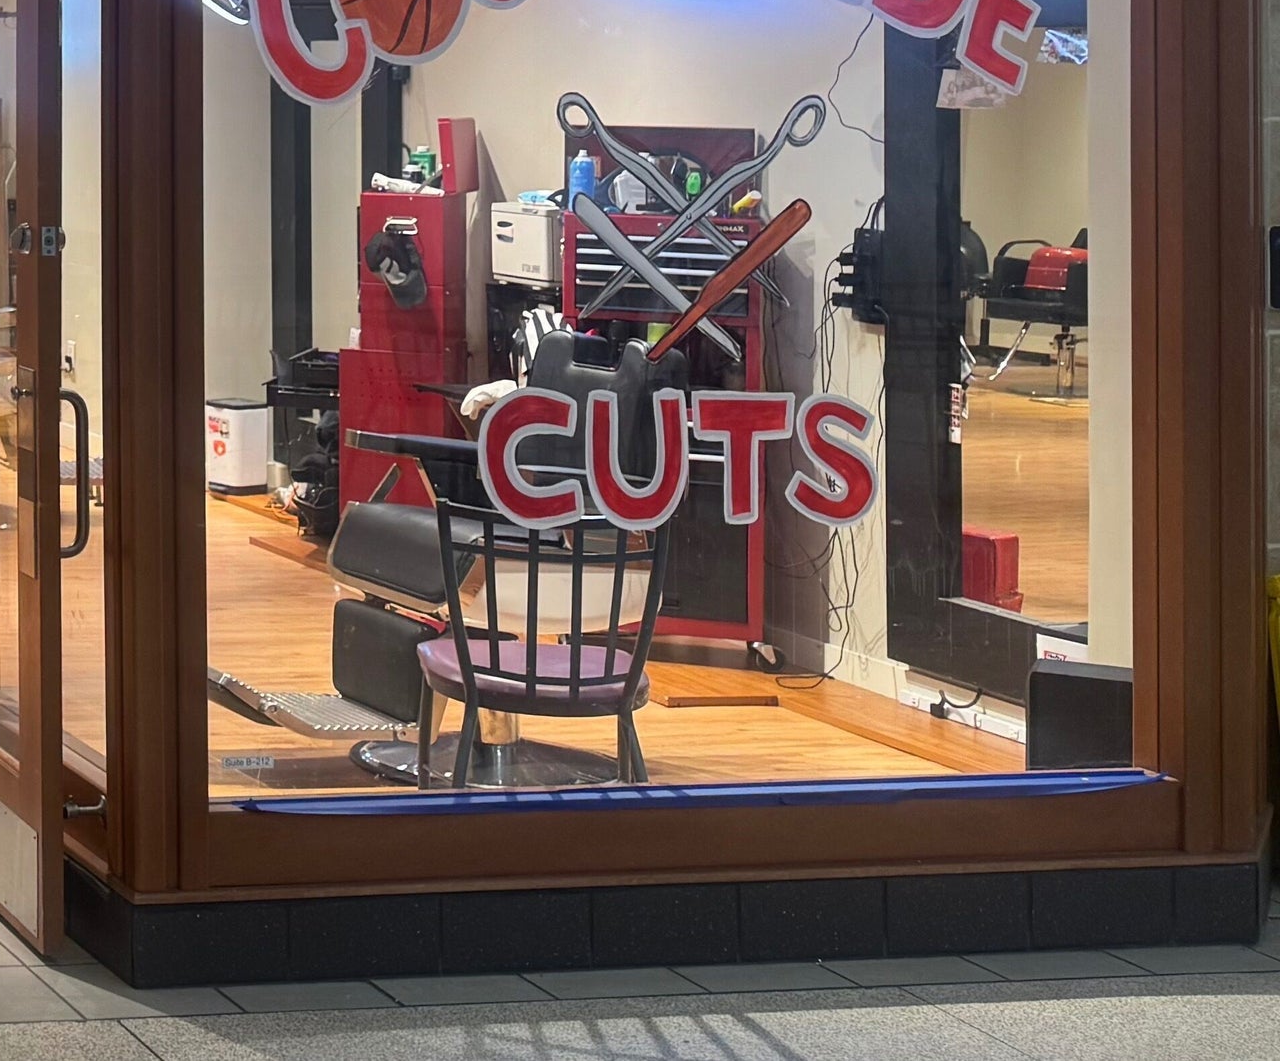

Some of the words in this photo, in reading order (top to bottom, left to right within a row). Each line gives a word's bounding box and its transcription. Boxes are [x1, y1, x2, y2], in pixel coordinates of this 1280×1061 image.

[480, 388, 877, 528] CUTS
[225, 758, 244, 767] Suite
[246, 757, 270, 766] B-212
